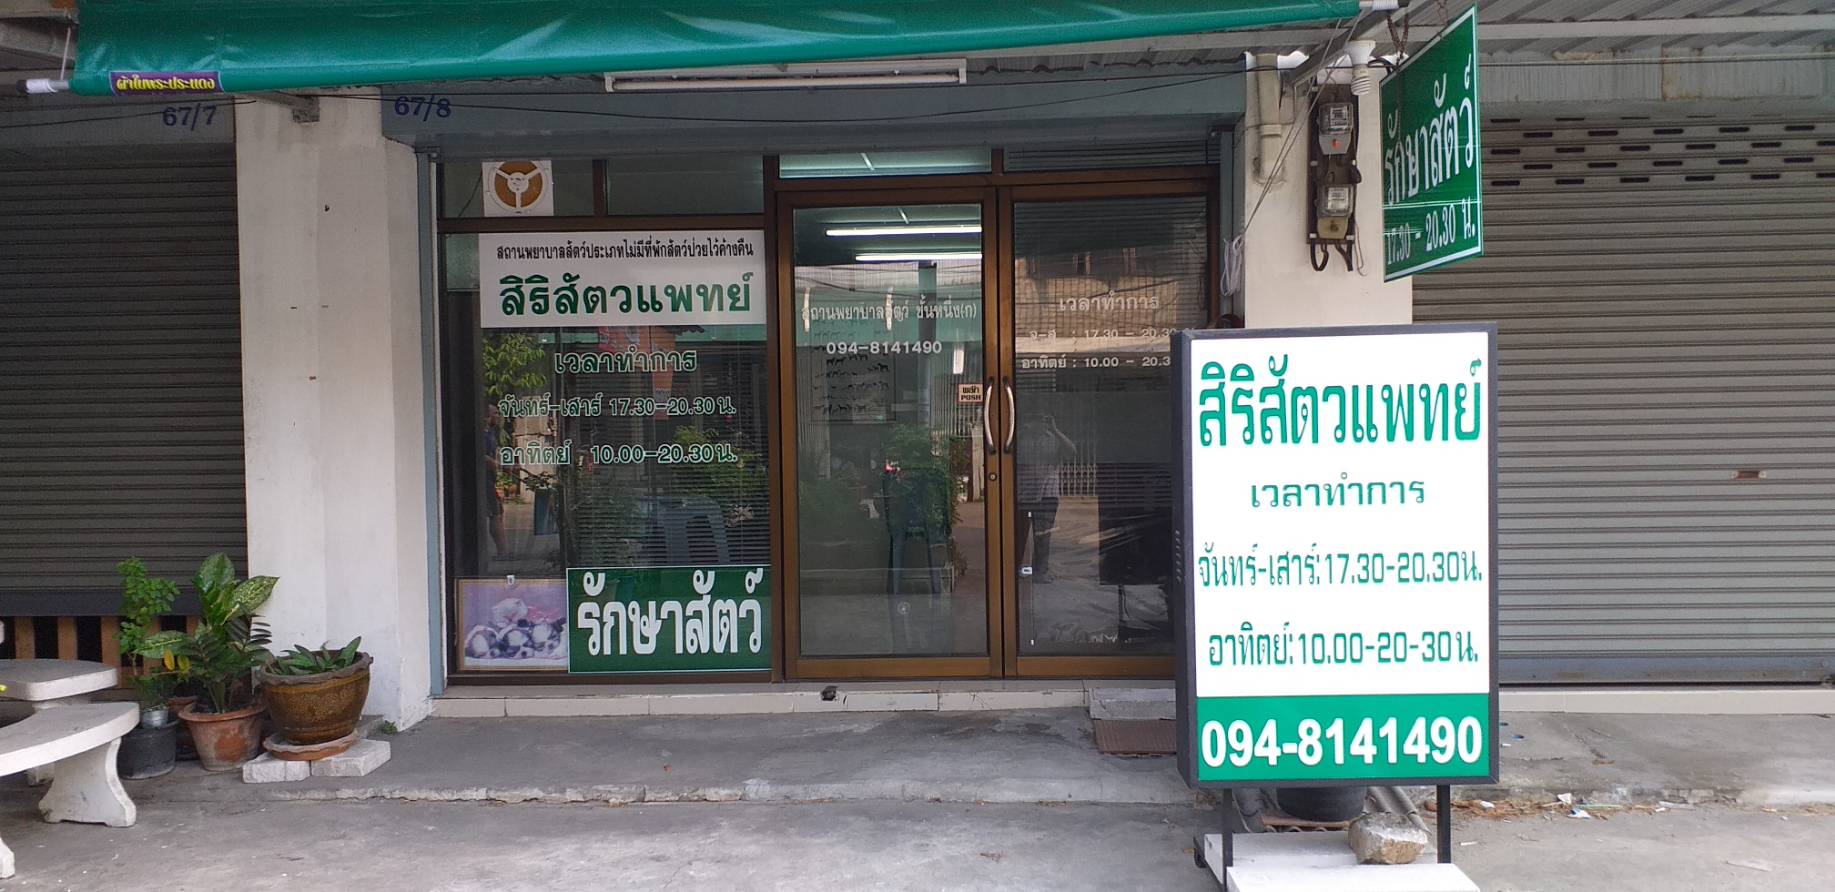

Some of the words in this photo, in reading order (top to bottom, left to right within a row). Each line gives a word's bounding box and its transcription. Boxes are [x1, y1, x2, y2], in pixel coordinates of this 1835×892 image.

[162, 102, 217, 131] 67/7
[394, 95, 452, 122] 67/8
[1385, 53, 1473, 208] รักษาสัตว์
[1386, 222, 1411, 265] 17.30
[1426, 203, 1456, 252] 20.30
[1462, 196, 1476, 240] น.
[500, 272, 754, 316] สิริสัตวแพทย์
[1059, 290, 1161, 312] เวลาทำการ
[554, 345, 698, 374] เวลาทำการ
[826, 340, 943, 355] 094-8141490
[1022, 354, 1067, 369] อาทิตย์
[1085, 357, 1119, 368] 10.00
[1142, 356, 1172, 367] 20.3
[498, 392, 603, 417] จันทร์-เสาร์
[1199, 354, 1482, 447] สิริสัตวแพทย์
[500, 439, 573, 465] อาทิตย์
[1251, 472, 1425, 507] เวลาทำการ
[577, 567, 765, 656] รักษาสัตว์
[1201, 716, 1483, 767] 094-8141490
